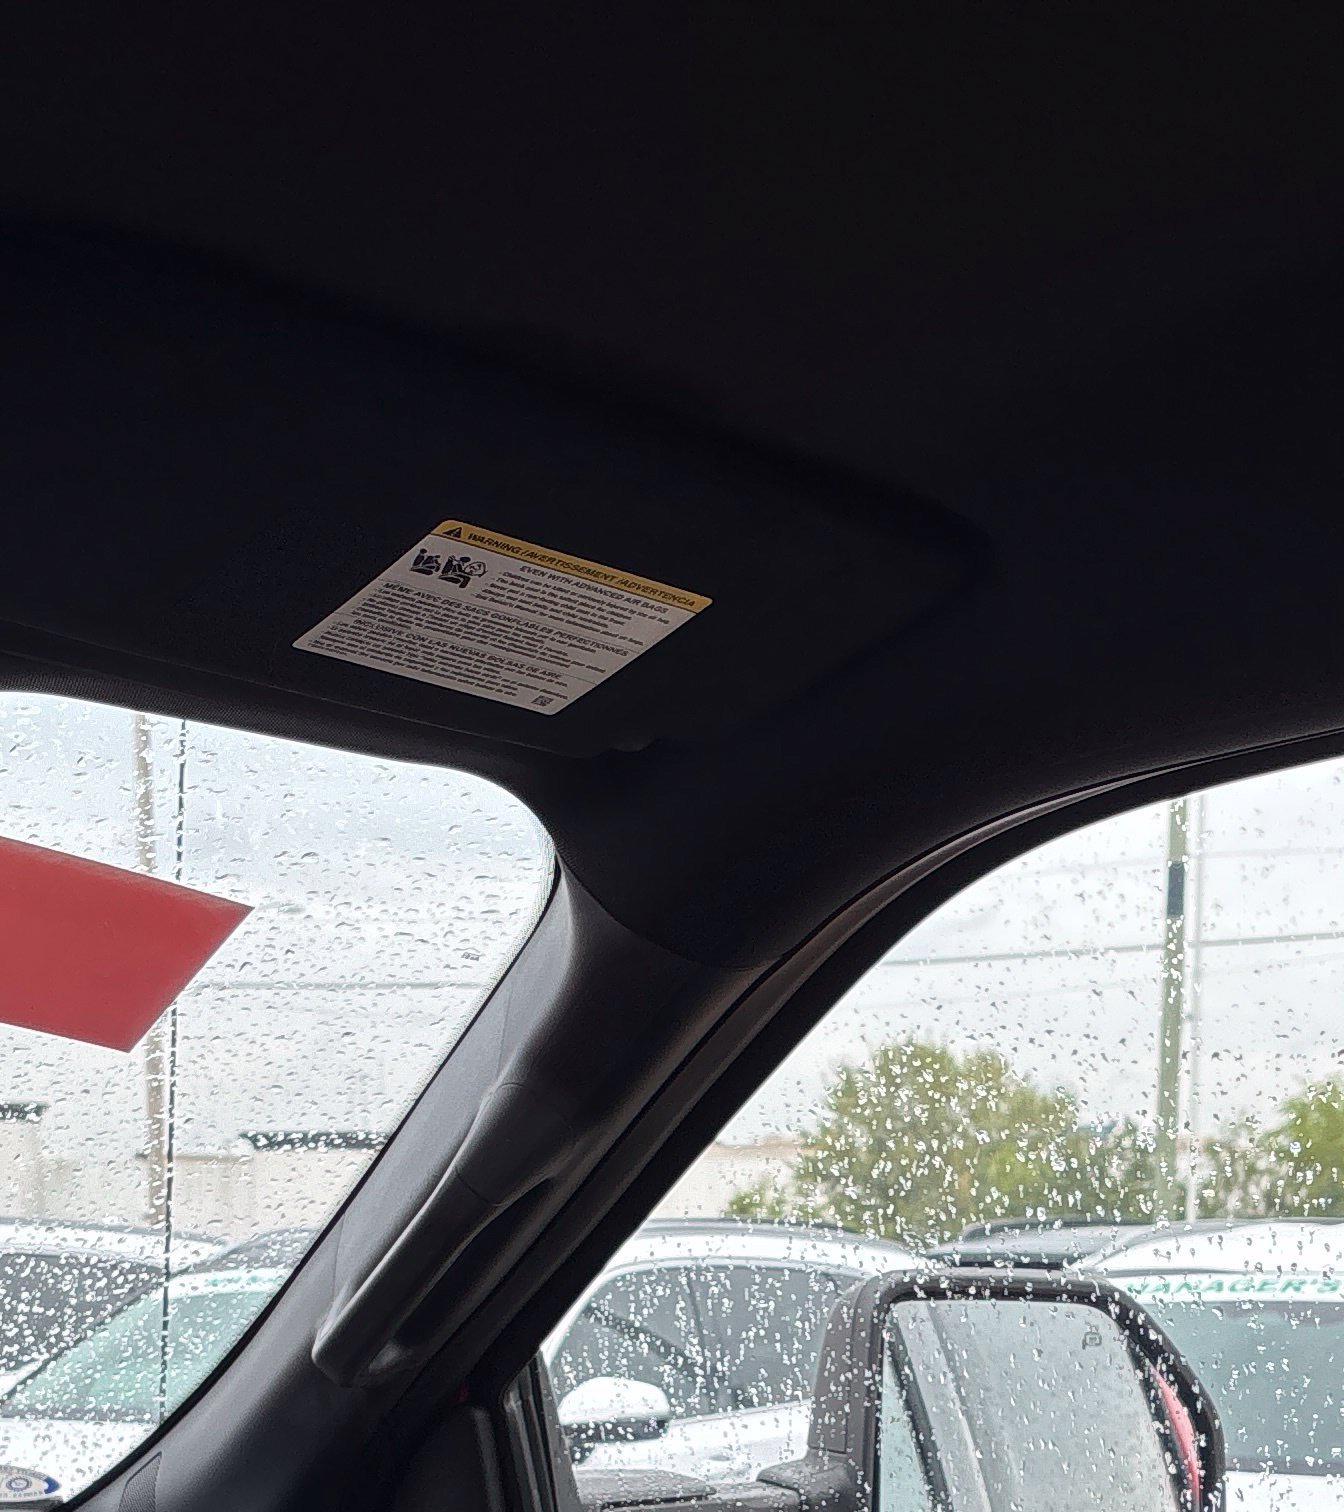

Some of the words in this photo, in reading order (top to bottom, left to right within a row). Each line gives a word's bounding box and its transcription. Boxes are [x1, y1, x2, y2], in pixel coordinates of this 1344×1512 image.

[467, 533, 522, 553] WARNING
[519, 566, 546, 577] EVEN
[546, 574, 572, 585] WITH
[571, 581, 623, 600] ADVANCED
[623, 596, 641, 605] AIR
[641, 602, 668, 613] BAGS
